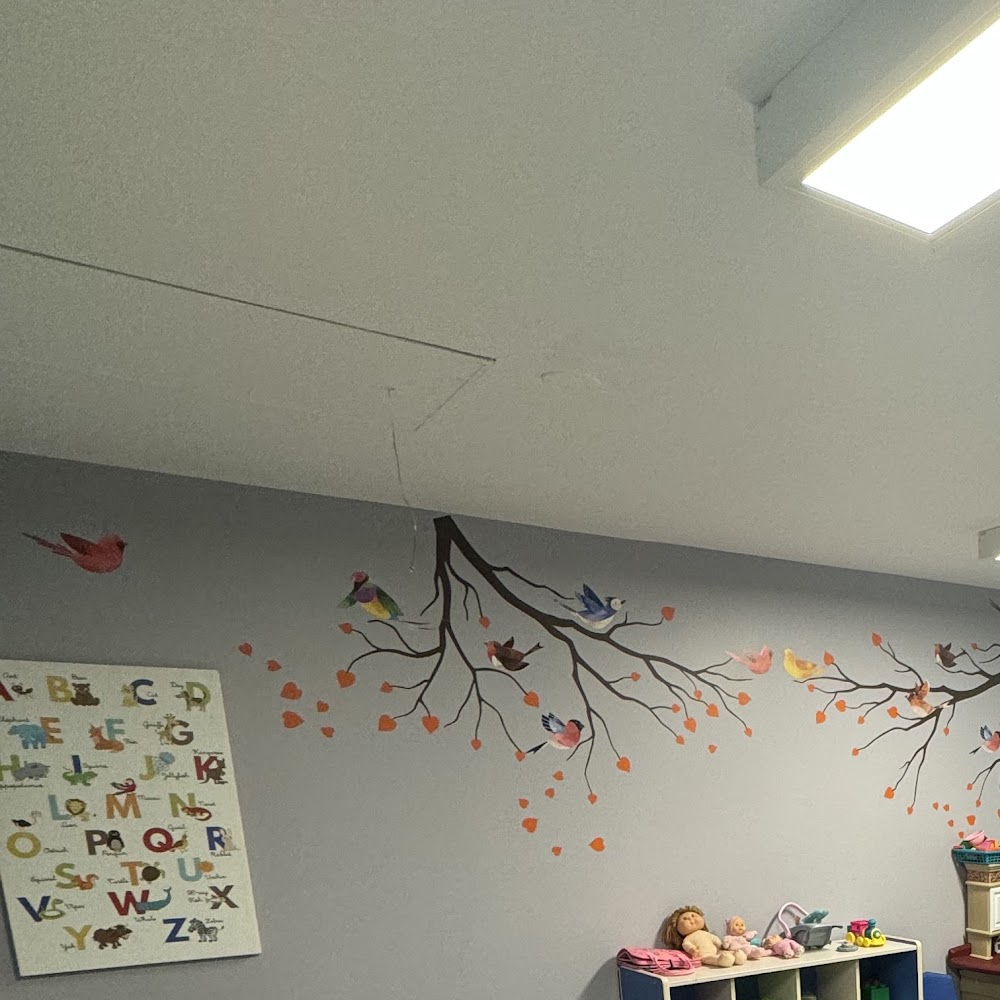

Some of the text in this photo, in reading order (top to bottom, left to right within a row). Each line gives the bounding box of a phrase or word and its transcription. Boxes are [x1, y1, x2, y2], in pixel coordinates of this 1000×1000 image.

[46, 676, 73, 702] B
[130, 679, 157, 706] C
[186, 682, 211, 707] D
[40, 717, 64, 744] E
[104, 719, 125, 742] F
[171, 720, 194, 746] G
[72, 755, 83, 774] I
[139, 755, 155, 781] J
[194, 756, 218, 781] K
[48, 795, 72, 820] L
[105, 793, 142, 819] M
[169, 793, 198, 818] N
[6, 832, 42, 859] O
[85, 830, 108, 855] P
[143, 828, 174, 853] Q
[206, 827, 227, 850] R
[55, 863, 77, 889] S
[120, 861, 145, 886] T
[177, 858, 204, 882] U
[17, 896, 50, 922] V
[107, 890, 150, 916] W
[209, 885, 240, 910] X
[63, 925, 92, 950] Y
[163, 917, 190, 943] Z
